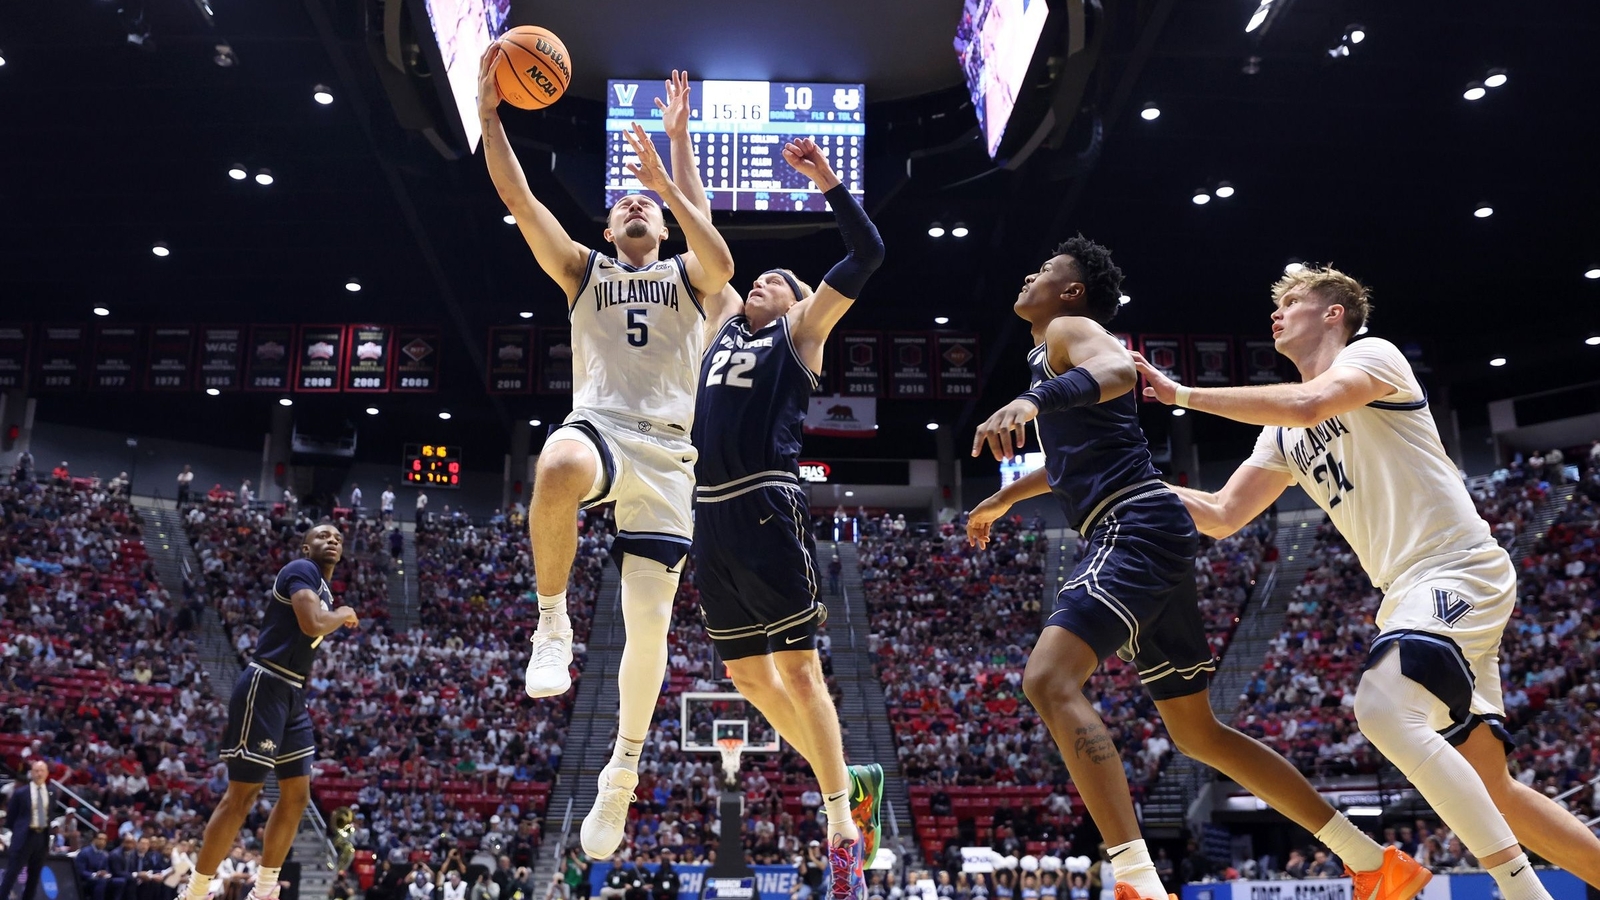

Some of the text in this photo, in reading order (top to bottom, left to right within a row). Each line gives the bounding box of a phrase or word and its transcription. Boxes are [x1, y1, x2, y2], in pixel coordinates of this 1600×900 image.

[535, 38, 570, 84] Wilson
[526, 65, 557, 97] NCAA
[785, 87, 812, 110] 10
[651, 108, 662, 117] FL
[713, 104, 761, 120] 15:16
[811, 111, 825, 120] FLS
[594, 279, 679, 312] VILLANOVA
[626, 309, 648, 347] 5
[205, 343, 238, 352] WAC
[706, 350, 757, 389] 22
[497, 380, 521, 389] 2010
[549, 380, 571, 389] 2011
[850, 384, 874, 393] 2015
[899, 384, 924, 394] 2016
[947, 384, 972, 394] 2016
[422, 445, 447, 457] 15:16
[413, 460, 421, 471] 6
[449, 462, 459, 473] 10
[1313, 451, 1354, 509] 24
